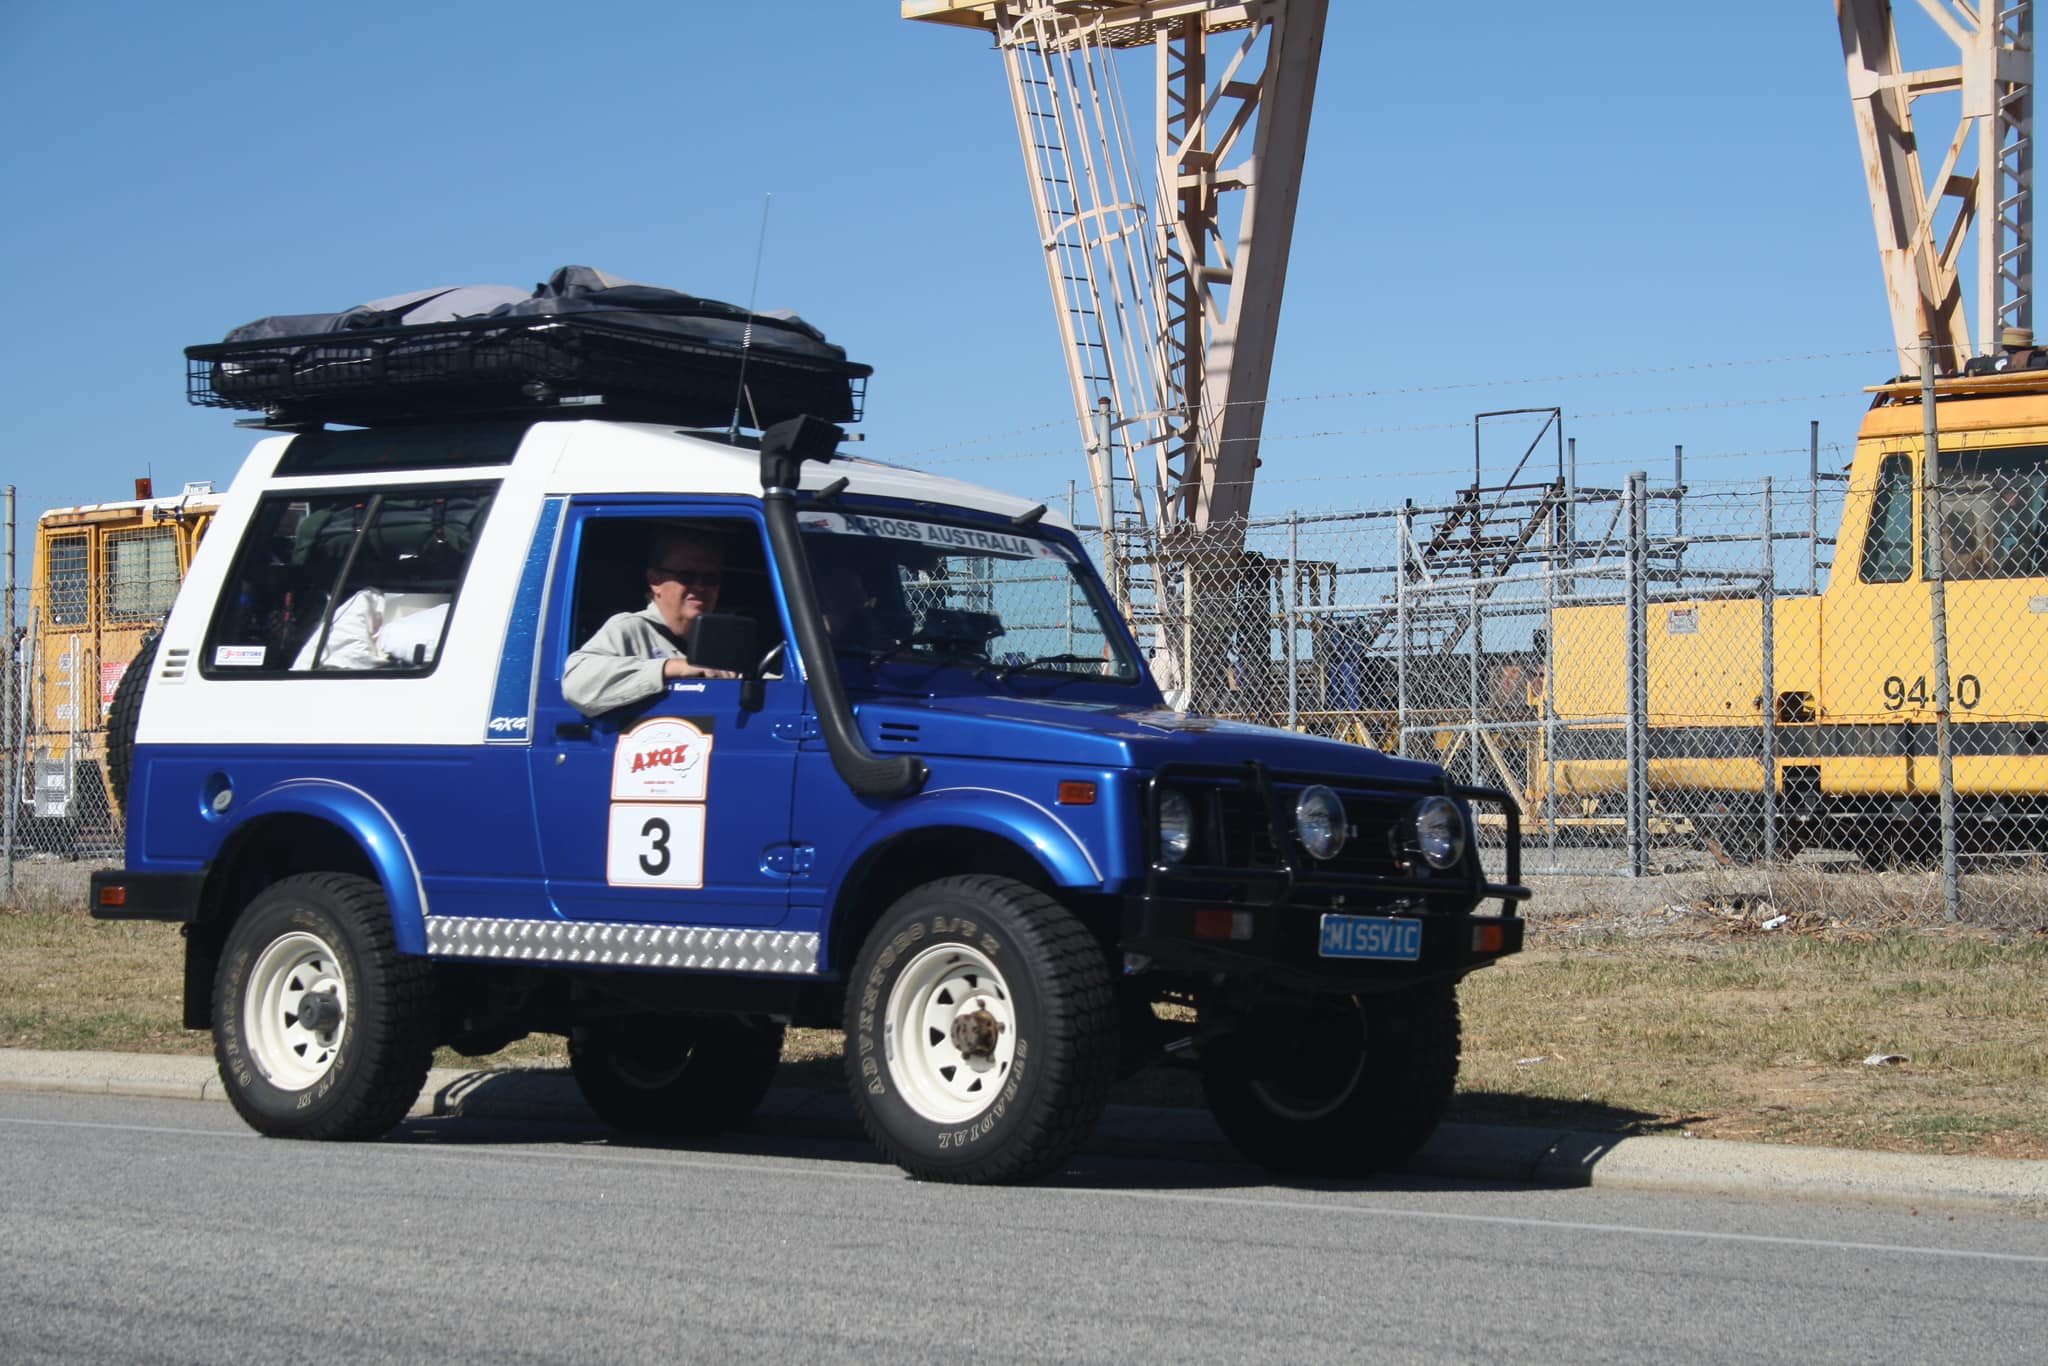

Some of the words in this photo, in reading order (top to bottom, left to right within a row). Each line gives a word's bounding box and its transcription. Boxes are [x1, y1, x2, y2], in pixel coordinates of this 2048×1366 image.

[927, 525, 1034, 555] AUSTRALIA
[631, 744, 688, 773] AXOZ
[638, 817, 671, 876] 3
[1328, 922, 1417, 953] MISSVIC
[938, 1078, 1018, 1149] RADIAL
